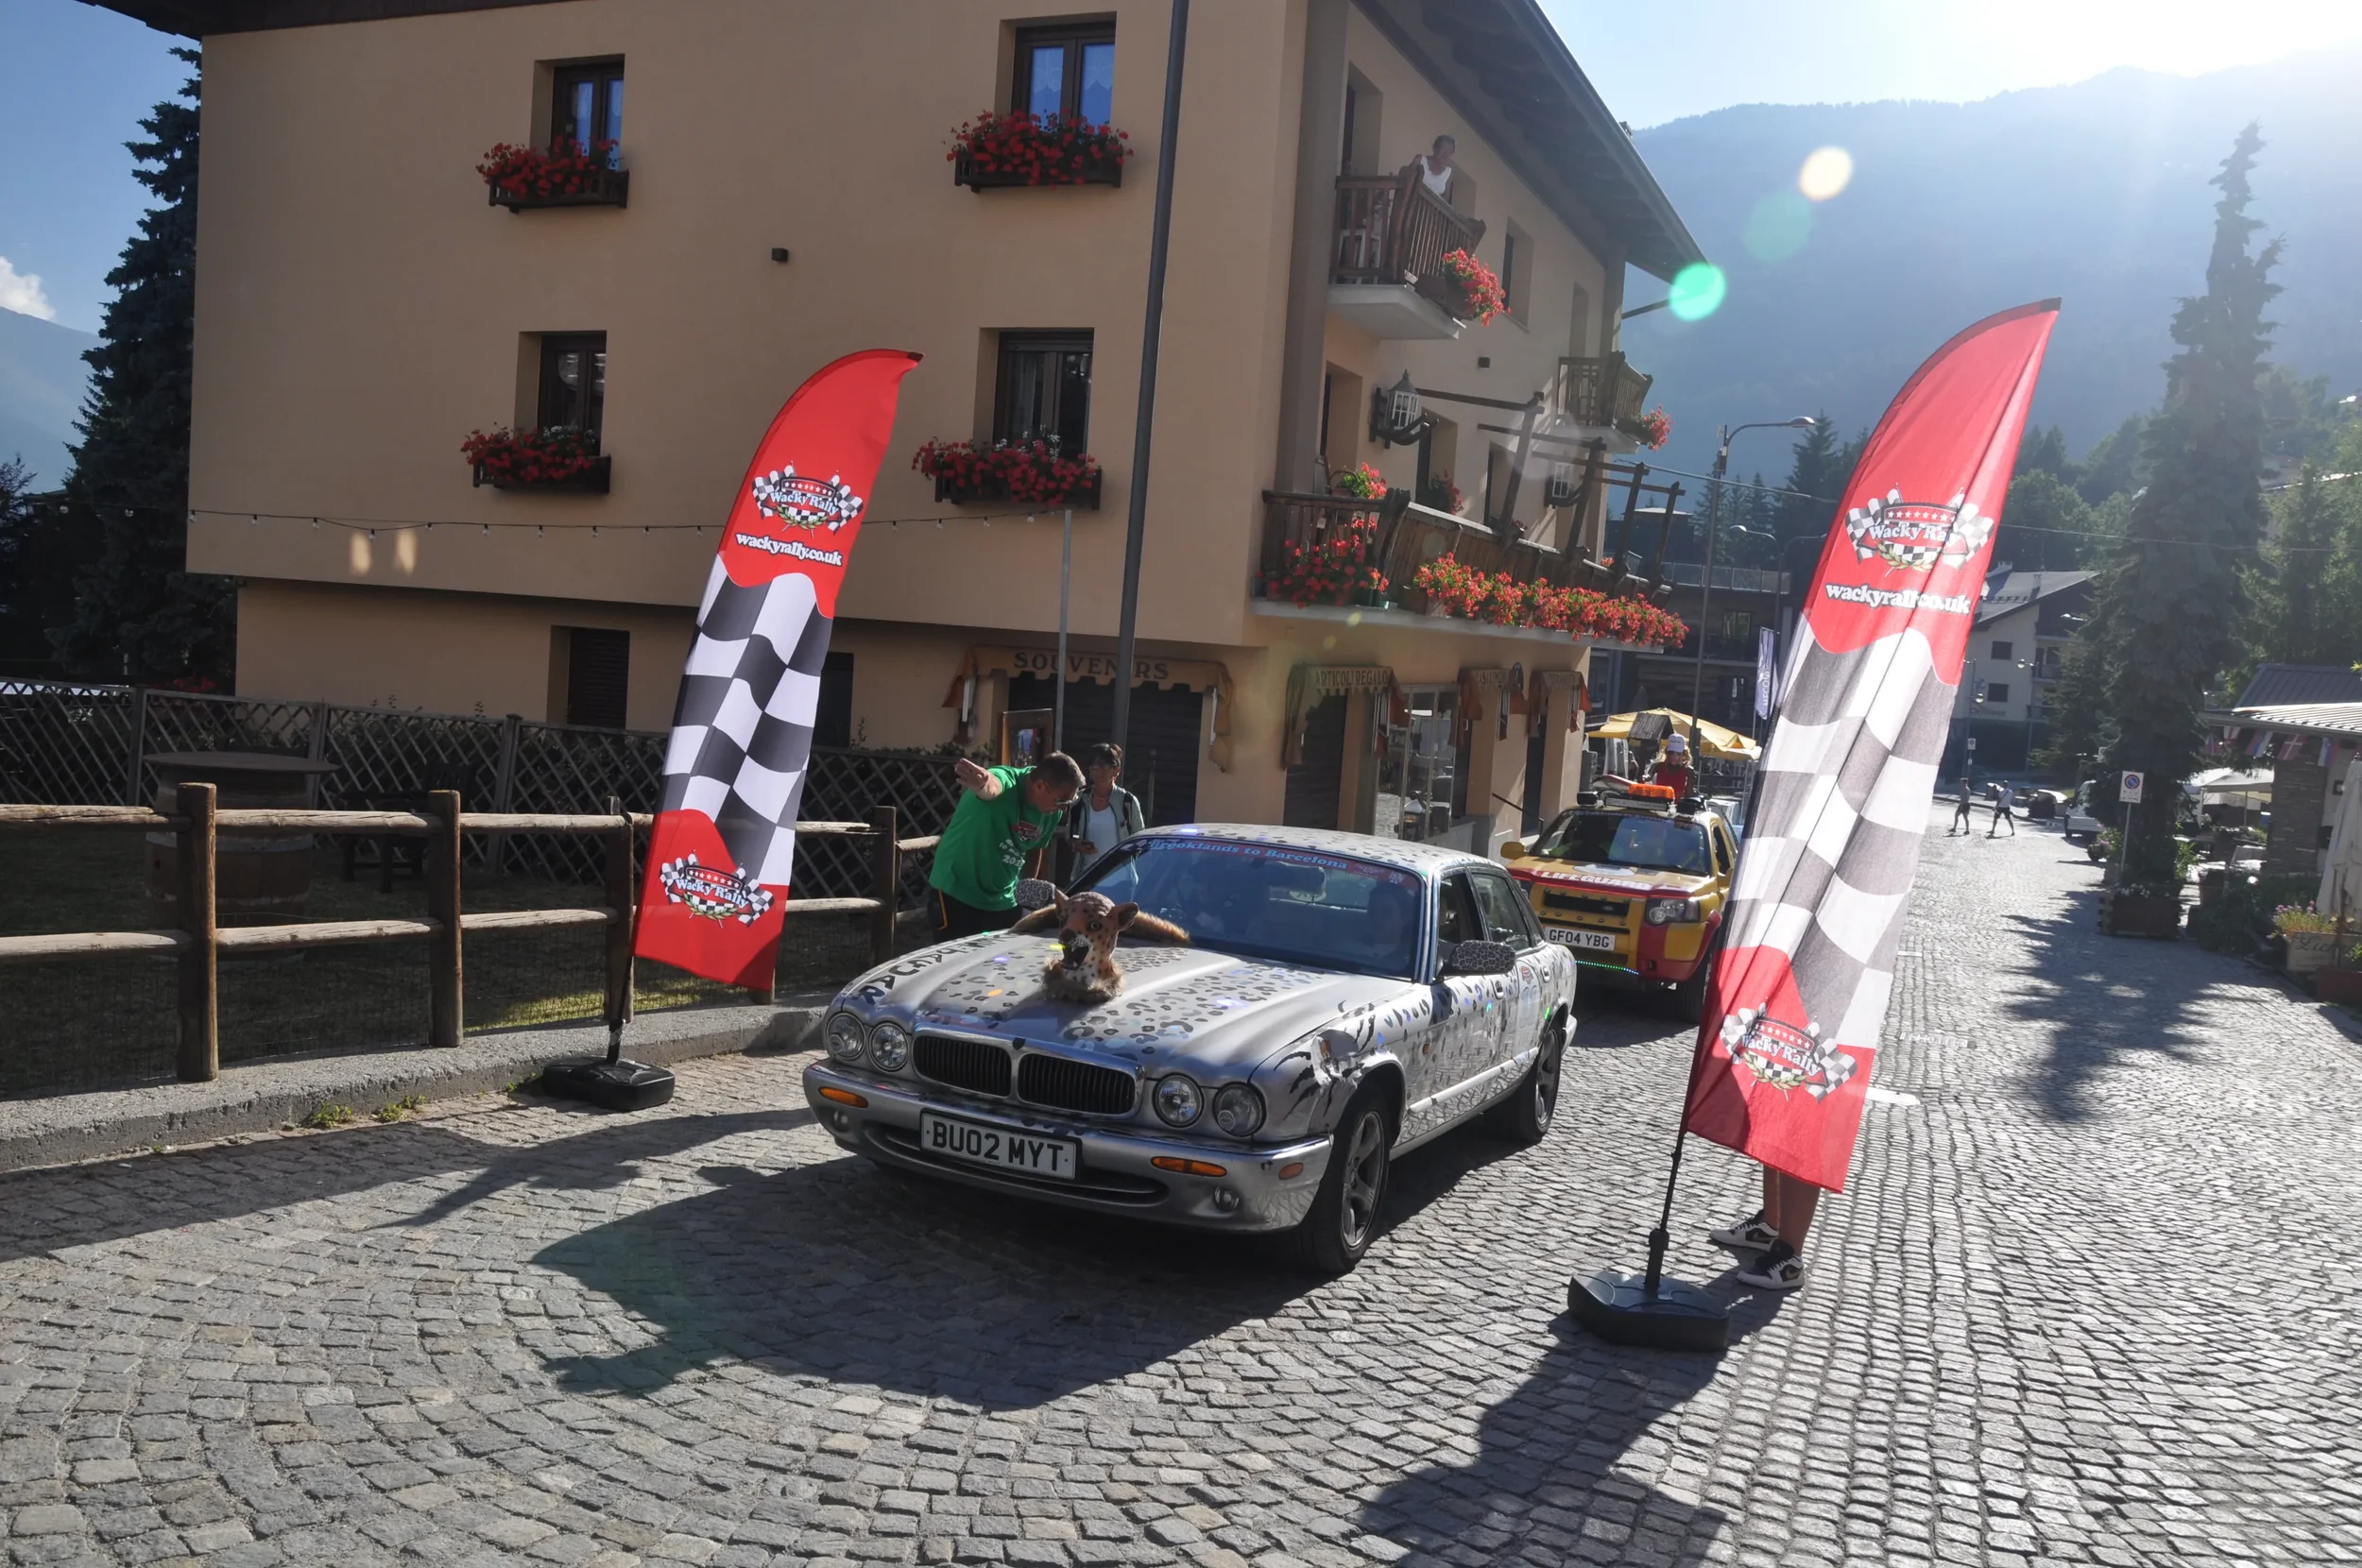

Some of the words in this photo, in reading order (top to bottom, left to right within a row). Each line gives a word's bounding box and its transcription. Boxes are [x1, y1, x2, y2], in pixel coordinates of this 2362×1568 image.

[770, 490, 808, 505] Wacky
[809, 495, 840, 517] Rally
[1869, 521, 1921, 540] Wacky
[735, 533, 843, 567] wackyrally.co.uk
[1824, 584, 1972, 614] wackyrallco.uk
[1013, 652, 1170, 680] SOUVENRS
[1315, 670, 1354, 687] ARTICOLI
[1356, 670, 1388, 687] REGALO
[1148, 838, 1239, 856] Brooklands
[1243, 846, 1261, 857] to
[1264, 849, 1348, 870] Barcelona
[675, 878, 712, 896] Wacky
[713, 885, 748, 909] Rally
[1541, 871, 1652, 891] LIFEGUARD
[1549, 929, 1582, 945] GF04
[1585, 932, 1610, 948] YBG
[1741, 1033, 1784, 1060] Wacky
[1783, 1046, 1822, 1077] Rally
[932, 1120, 1001, 1161] BU02
[1008, 1136, 1064, 1172] MYT
